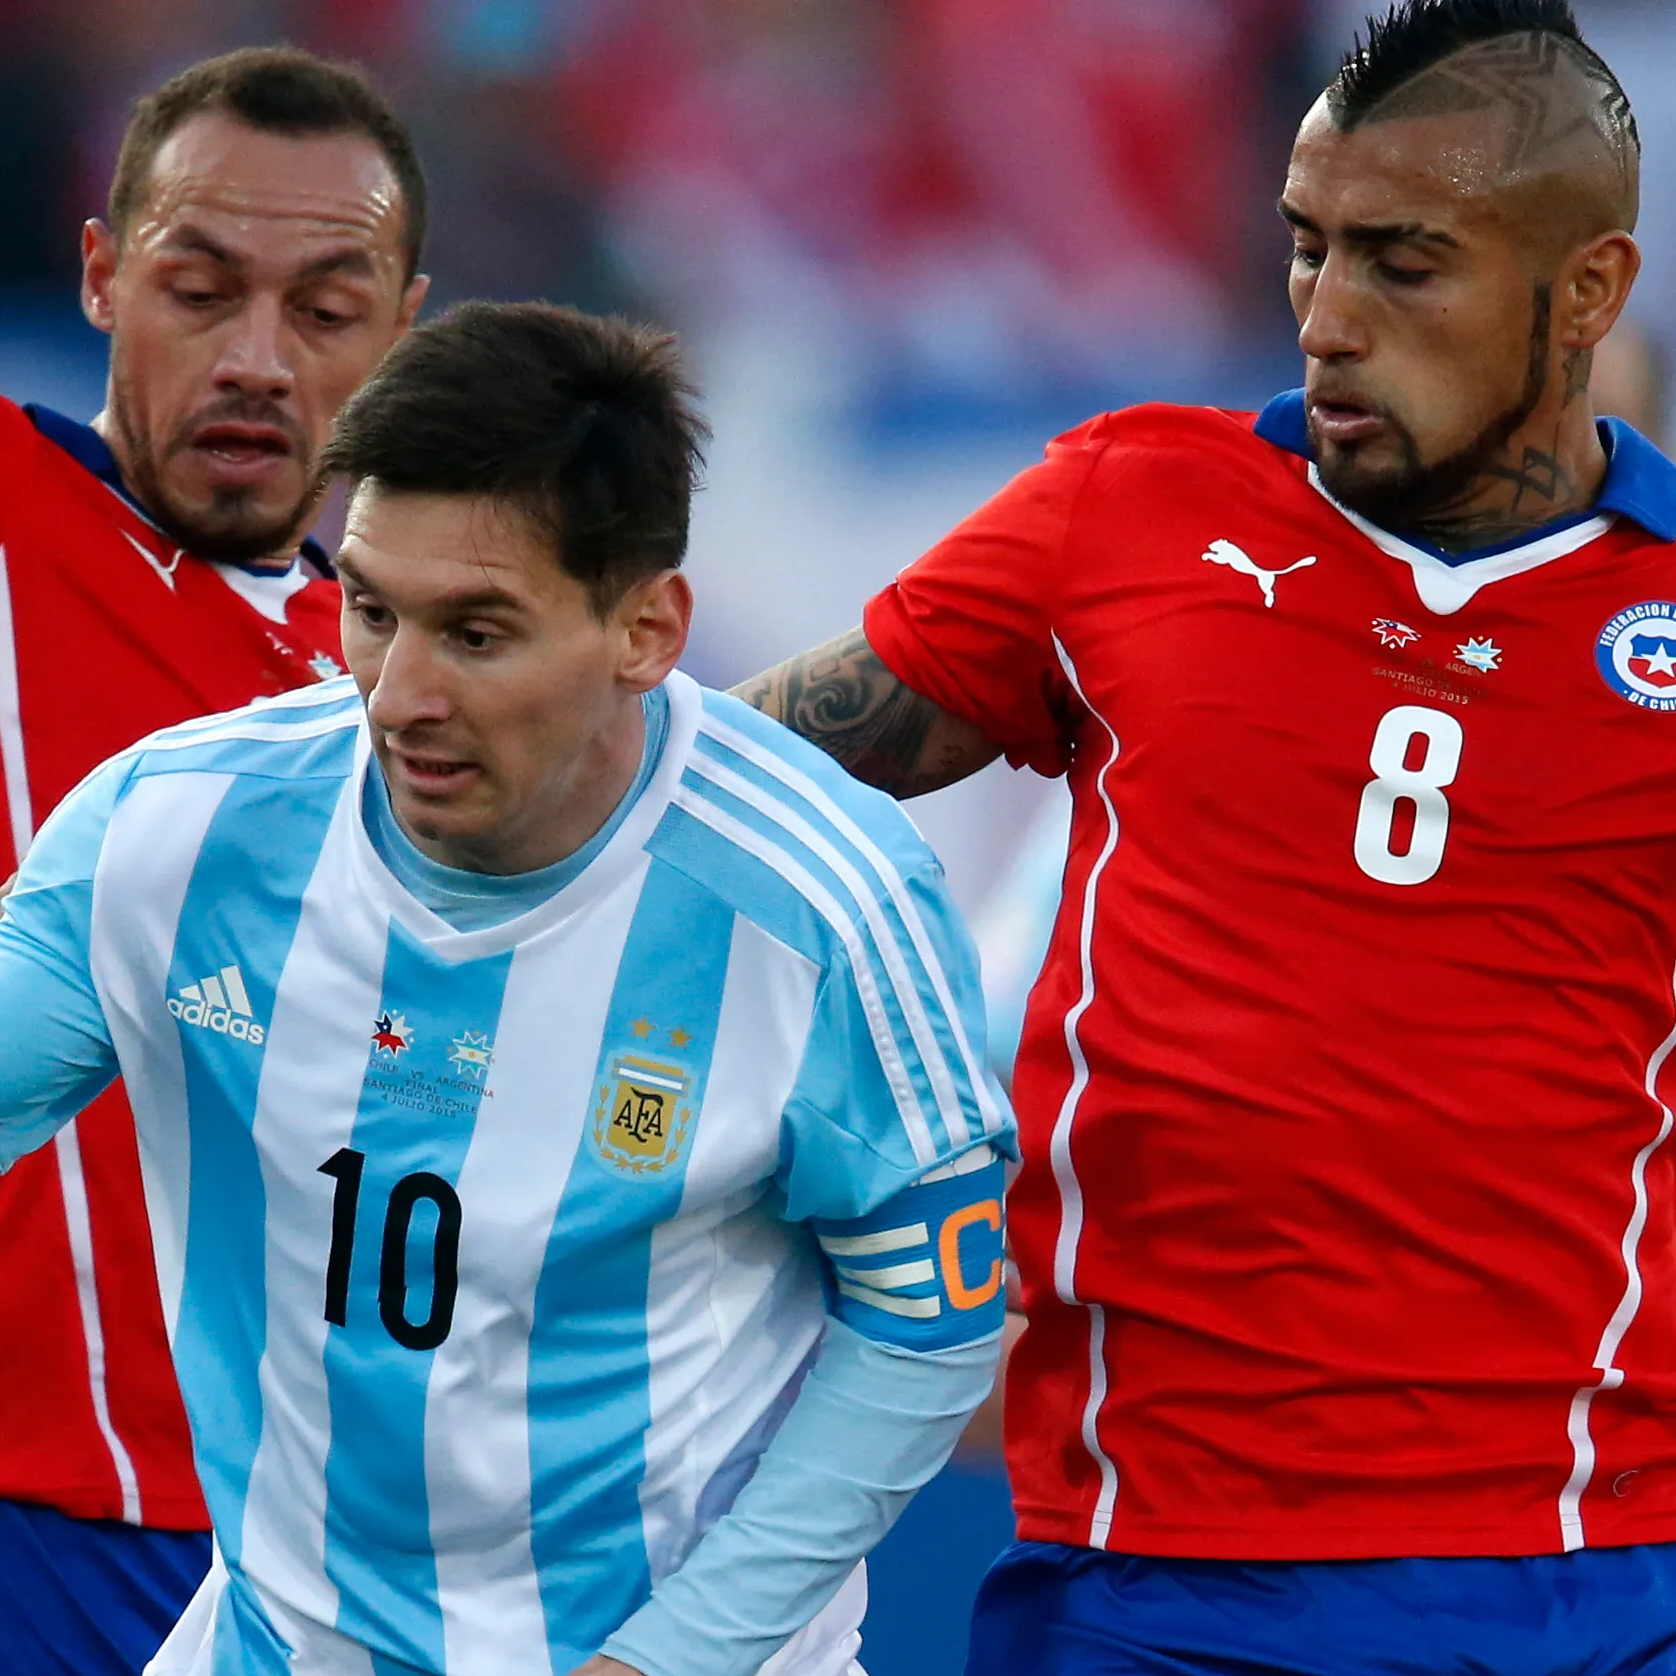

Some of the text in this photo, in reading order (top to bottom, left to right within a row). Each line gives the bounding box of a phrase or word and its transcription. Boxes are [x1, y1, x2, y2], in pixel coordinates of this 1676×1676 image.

[1599, 603, 1670, 647] FEDERACION
[1440, 691, 1469, 705] 2015
[1628, 691, 1648, 707] DE
[1353, 705, 1464, 886] 8
[167, 998, 265, 1045] adidas
[363, 1077, 477, 1114] SANTIAGO DE CHILE
[369, 1058, 399, 1073] CHILE
[435, 1076, 494, 1098] ARGENTINA
[405, 1079, 438, 1094] FINAL
[392, 1096, 425, 1111] JULIO
[429, 1107, 457, 1119] 2015
[613, 1086, 664, 1143] AFA
[316, 1147, 462, 1351] 10
[938, 1199, 1002, 1311] C
